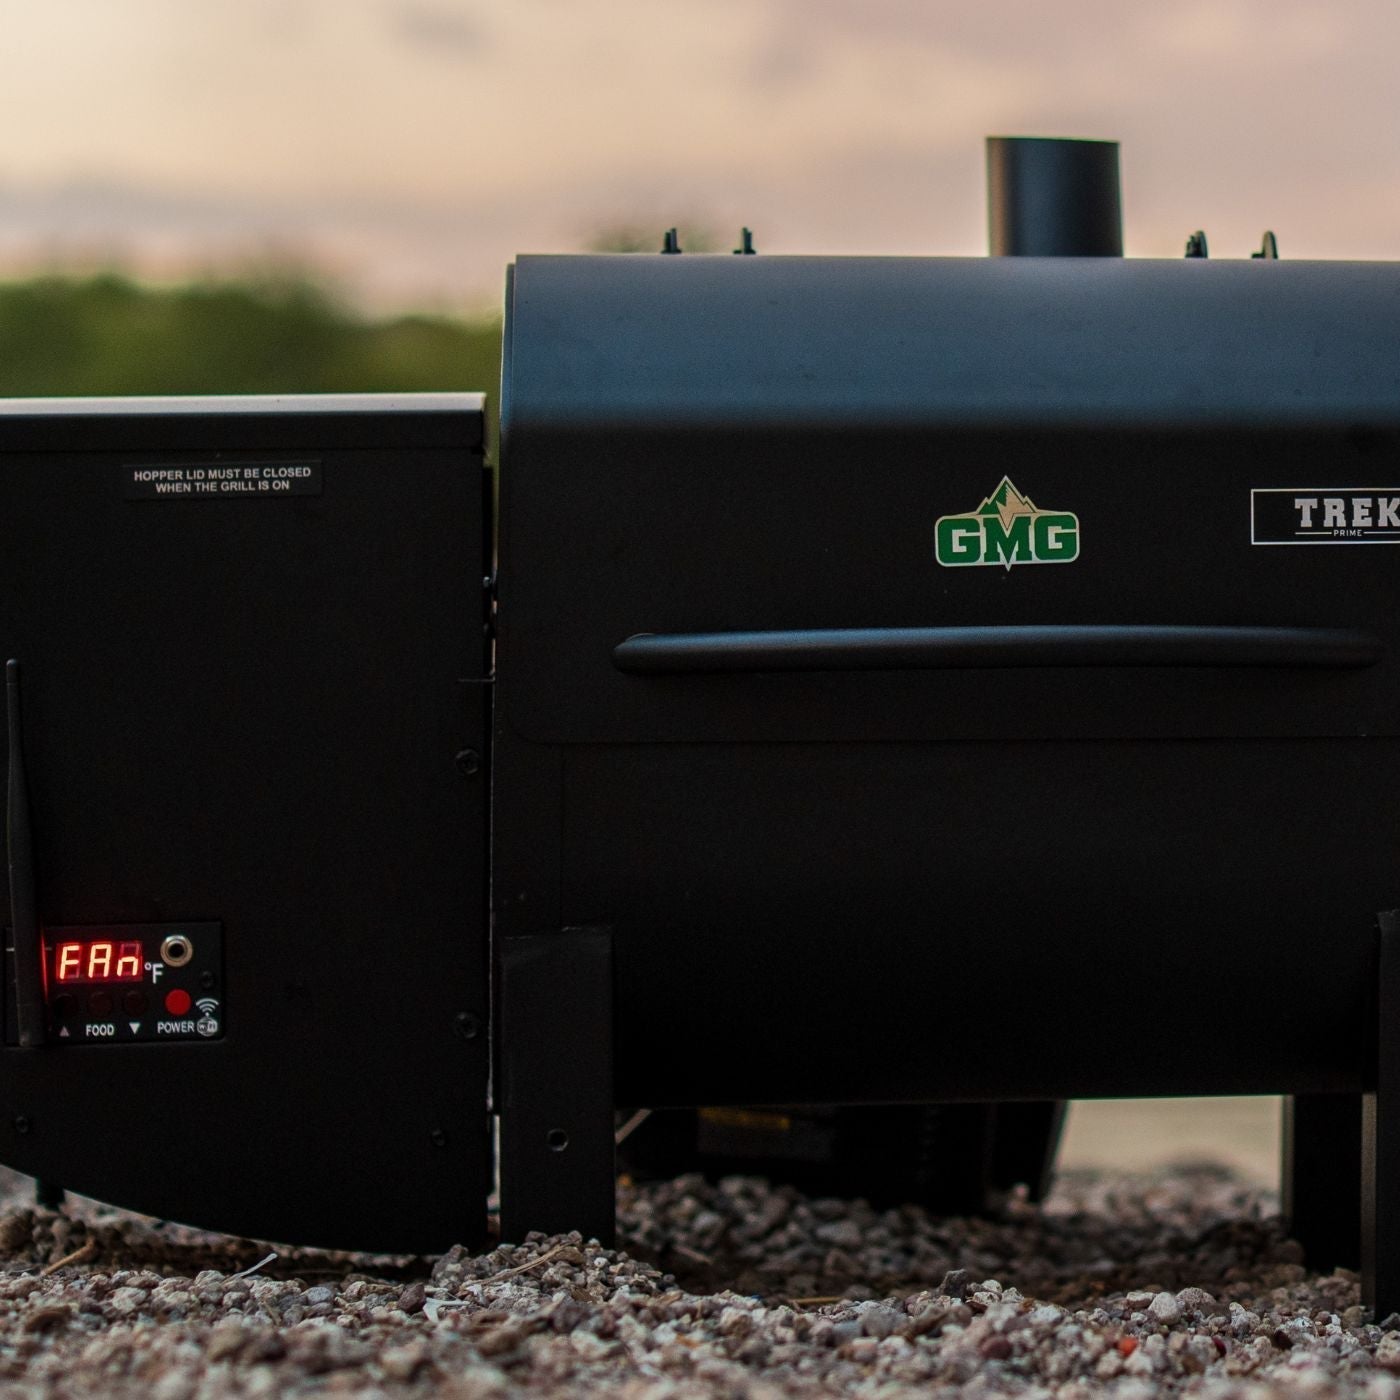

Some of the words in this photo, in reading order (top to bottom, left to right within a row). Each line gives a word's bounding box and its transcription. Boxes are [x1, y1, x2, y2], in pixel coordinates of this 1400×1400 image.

[134, 470, 183, 481] HOPPER
[186, 469, 204, 480] LID
[208, 468, 240, 480] MUST
[244, 468, 260, 478] BE
[263, 467, 311, 478] CLOSED
[156, 482, 191, 493] WHEN
[196, 481, 217, 492] THE
[220, 481, 255, 491] GRILL
[258, 480, 269, 490] IS
[272, 480, 290, 490] ON
[1295, 498, 1400, 528] TREK
[937, 514, 1077, 564] GMG
[1333, 529, 1363, 537] PRIME
[86, 1024, 115, 1036] FOOD
[157, 1021, 195, 1033] POWER
